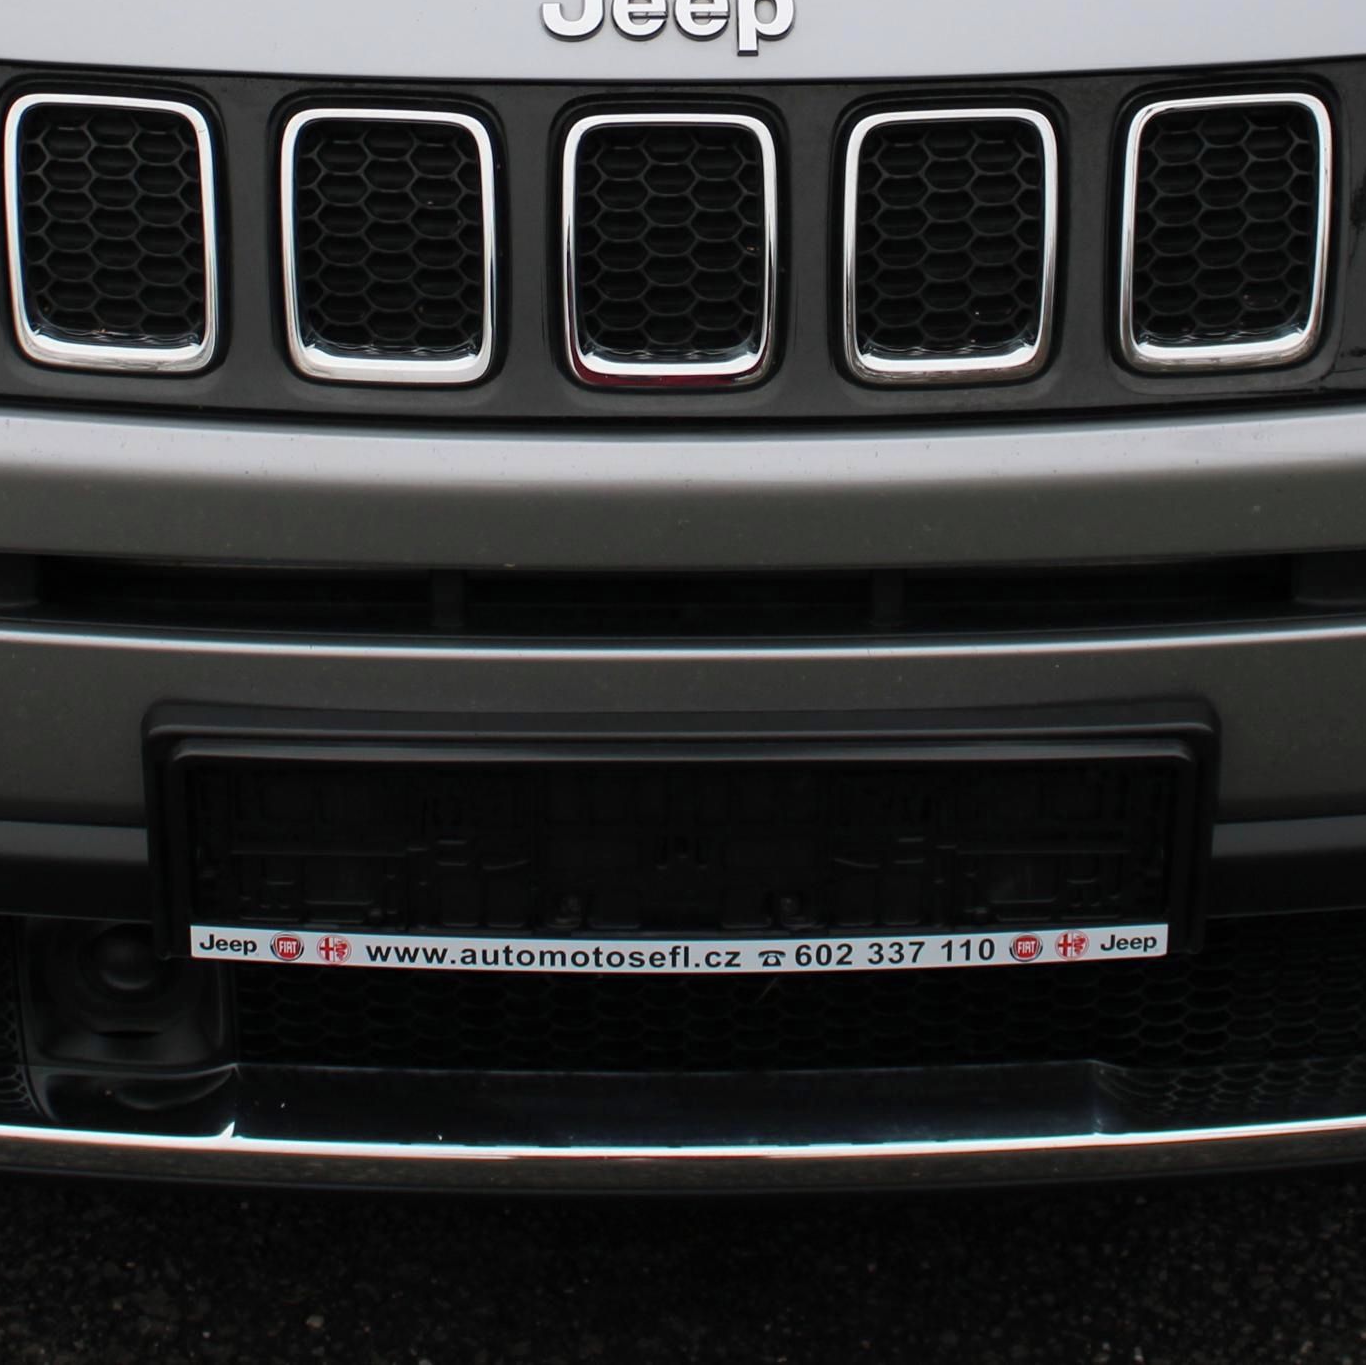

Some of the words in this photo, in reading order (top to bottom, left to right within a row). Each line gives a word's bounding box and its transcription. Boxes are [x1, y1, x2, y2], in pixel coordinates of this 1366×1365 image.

[199, 934, 257, 955] Jeep
[278, 940, 297, 954] FIAT
[366, 943, 742, 969] www.automotosefl.cz
[793, 942, 854, 967] 602
[867, 939, 926, 965] 337
[939, 937, 996, 963] 110
[1017, 940, 1036, 954] FIAT
[1100, 934, 1157, 952] Jeep
